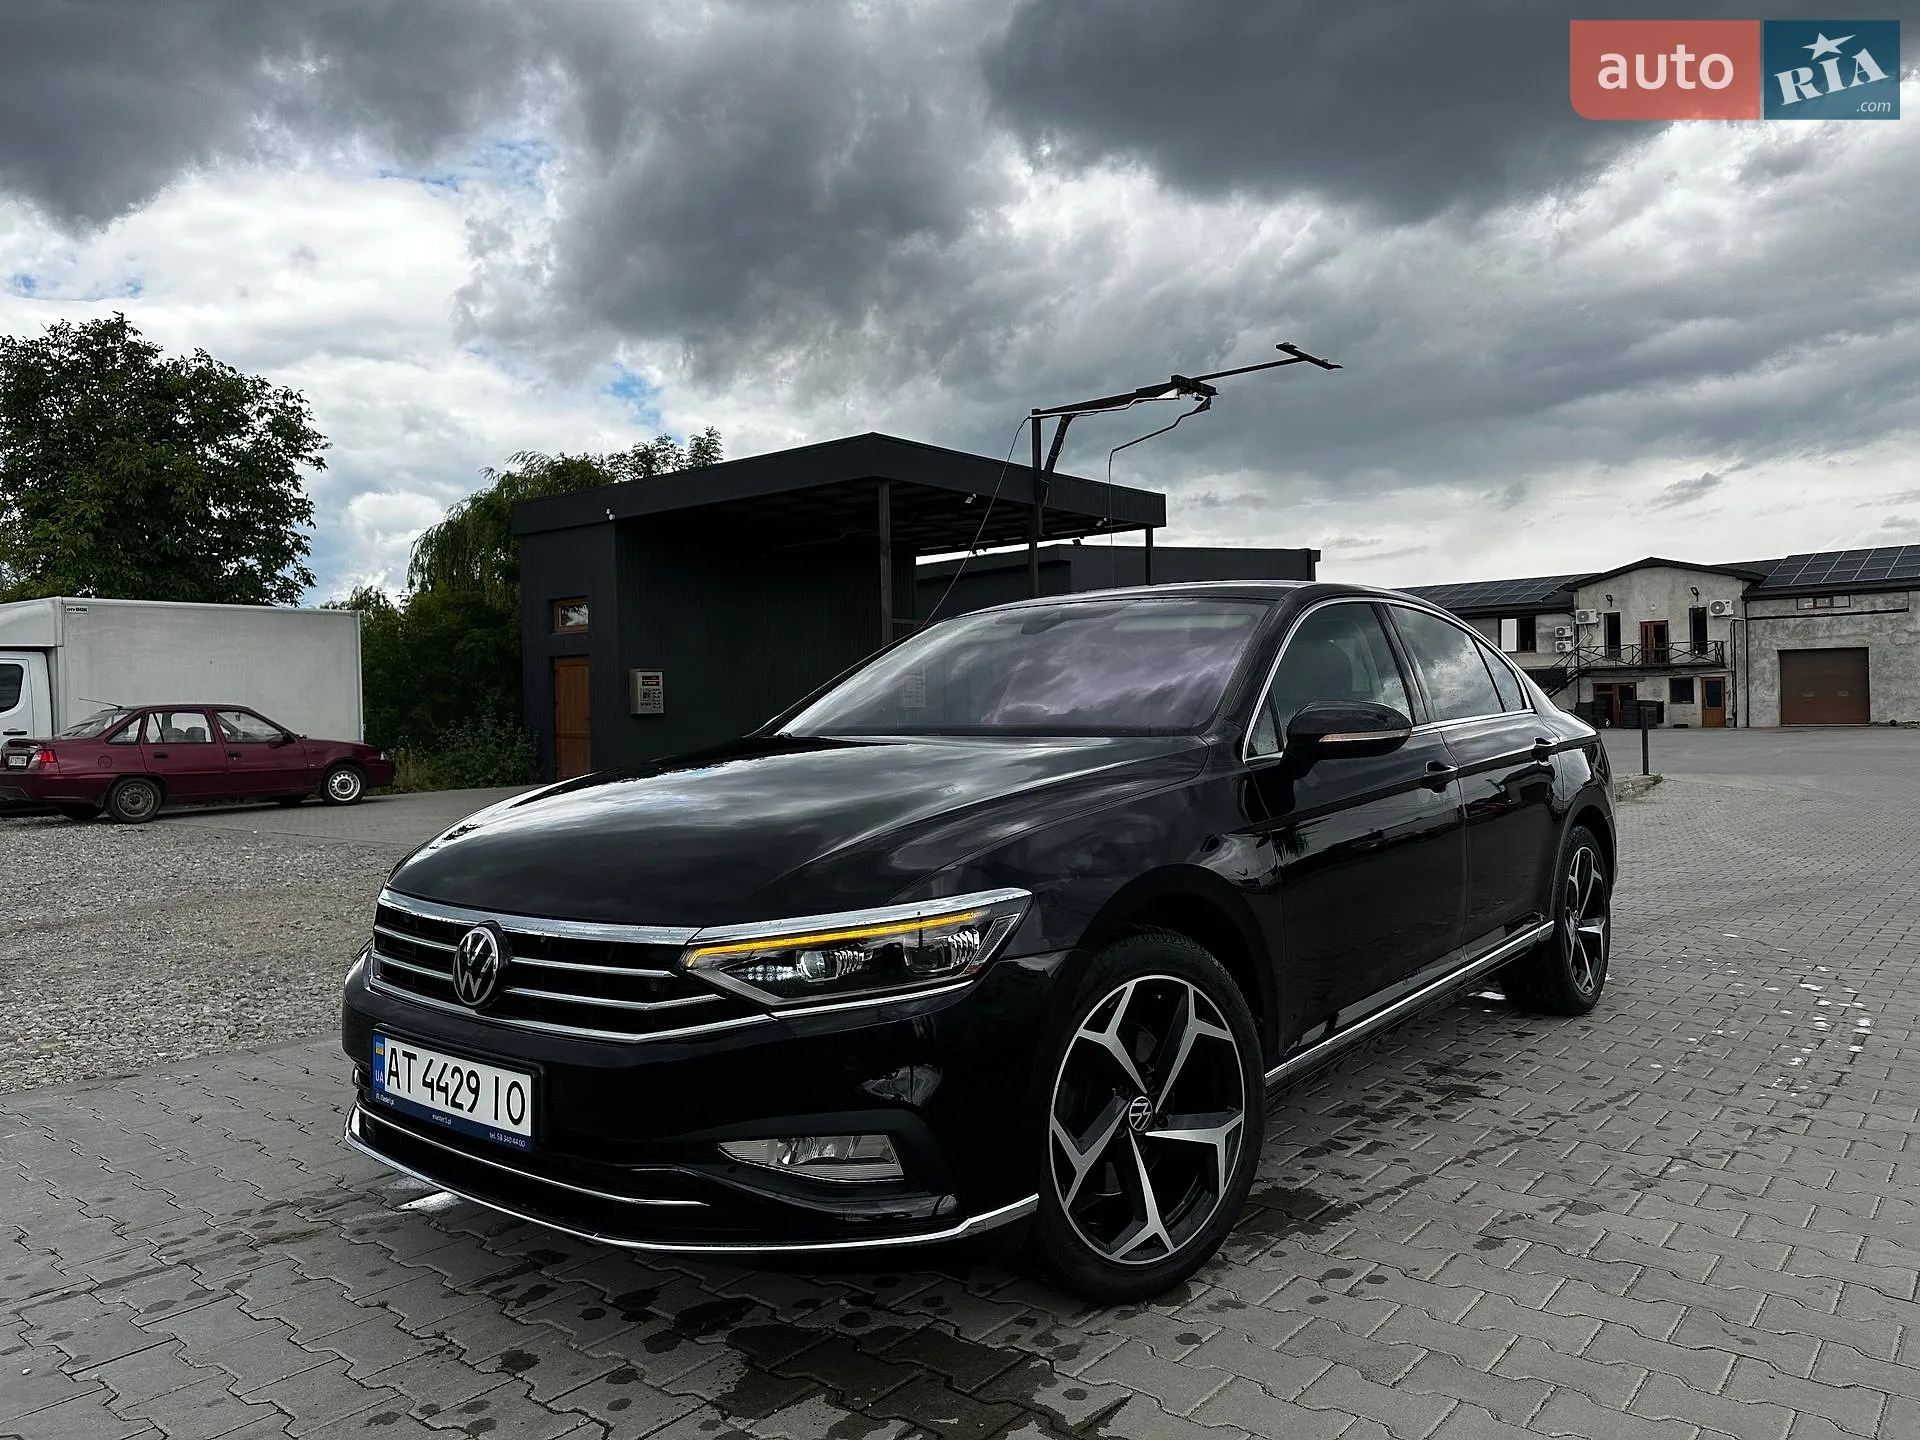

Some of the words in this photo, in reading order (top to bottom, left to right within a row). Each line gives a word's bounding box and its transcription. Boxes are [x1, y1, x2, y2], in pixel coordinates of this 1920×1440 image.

[375, 1069, 384, 1082] UA
[387, 1047, 417, 1094] AT
[421, 1059, 481, 1114] 4429
[494, 1075, 526, 1126] IO
